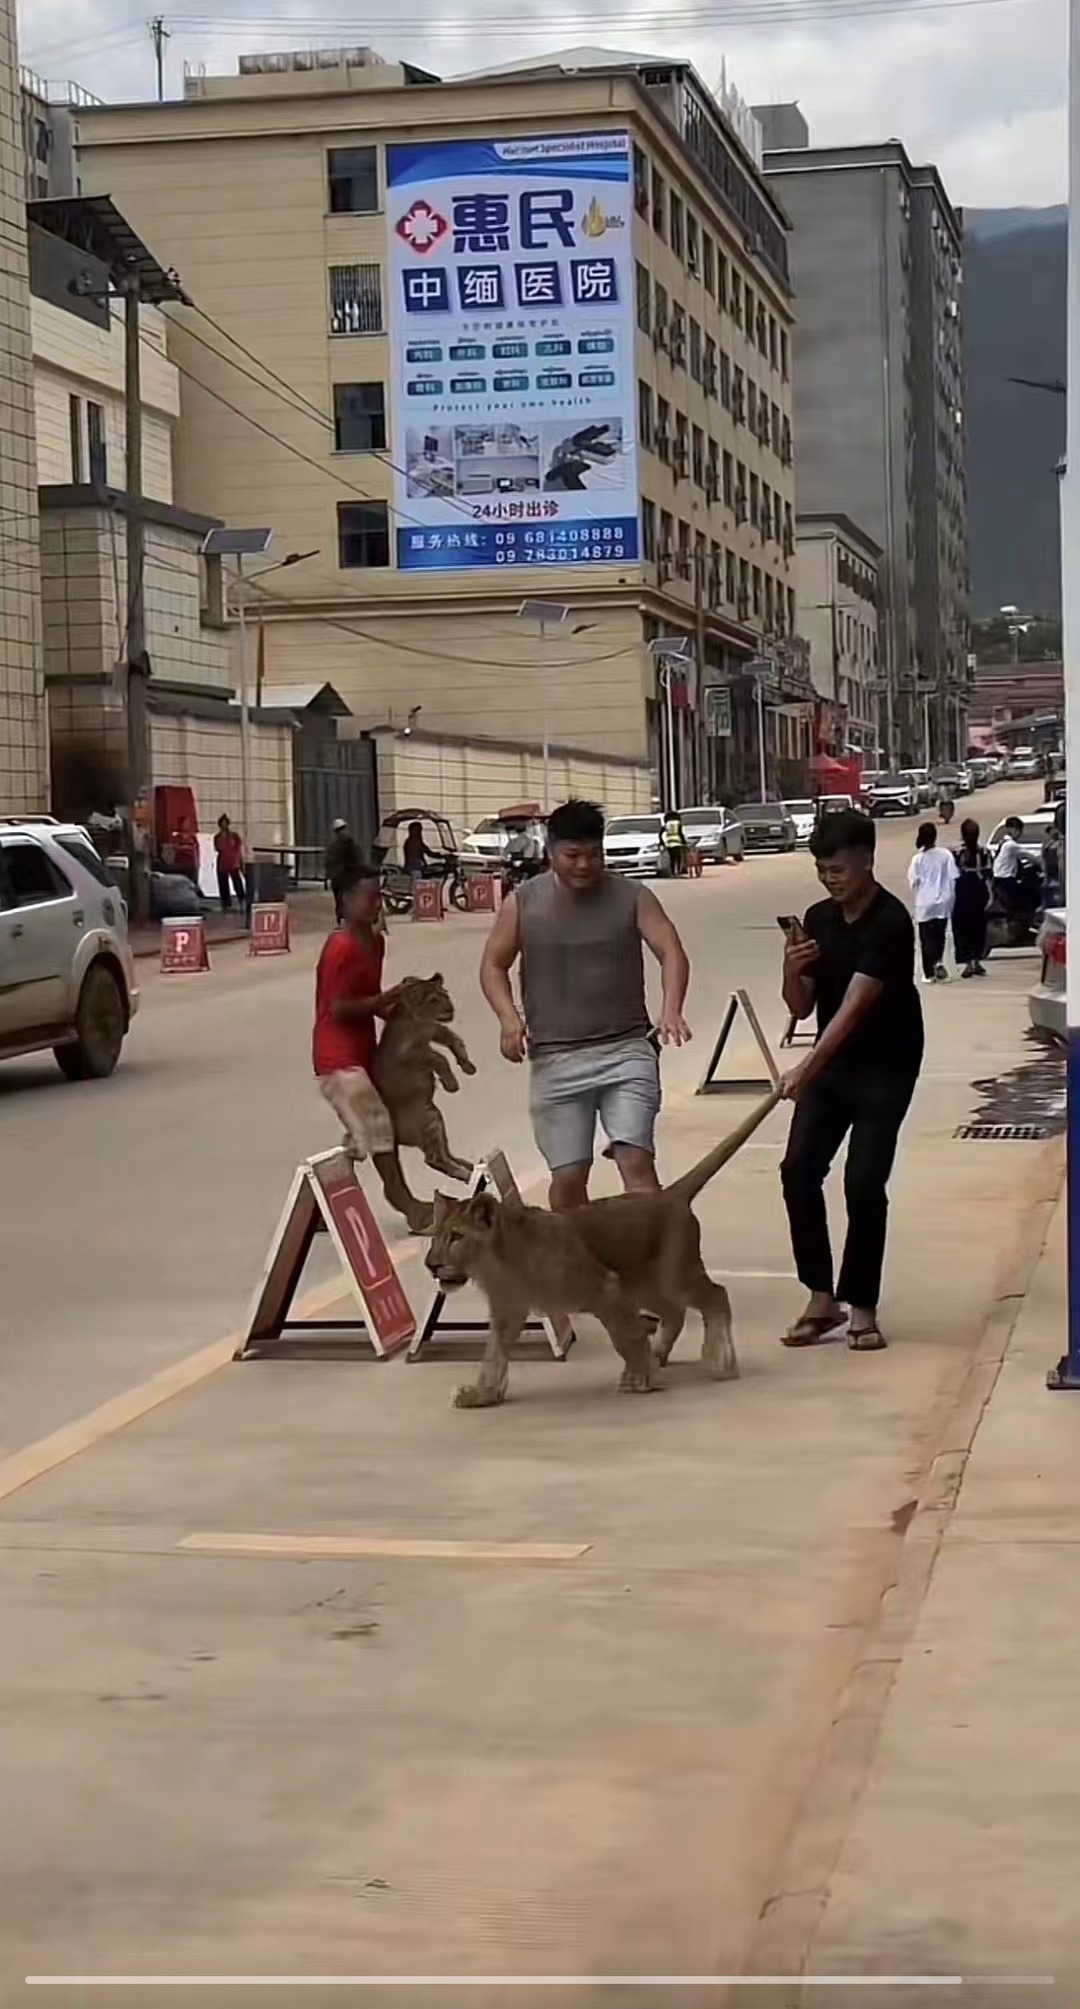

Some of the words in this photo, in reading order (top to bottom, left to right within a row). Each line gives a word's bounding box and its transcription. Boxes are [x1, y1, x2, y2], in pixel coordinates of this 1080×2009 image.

[452, 189, 576, 254] 惠民
[409, 262, 611, 308] 中缅医院
[473, 501, 559, 518] 24小时出诊
[495, 532, 515, 545] 09
[496, 550, 516, 563] 09
[420, 893, 434, 908] P
[474, 885, 487, 901] P
[175, 931, 190, 952] P
[344, 1205, 377, 1279] P
